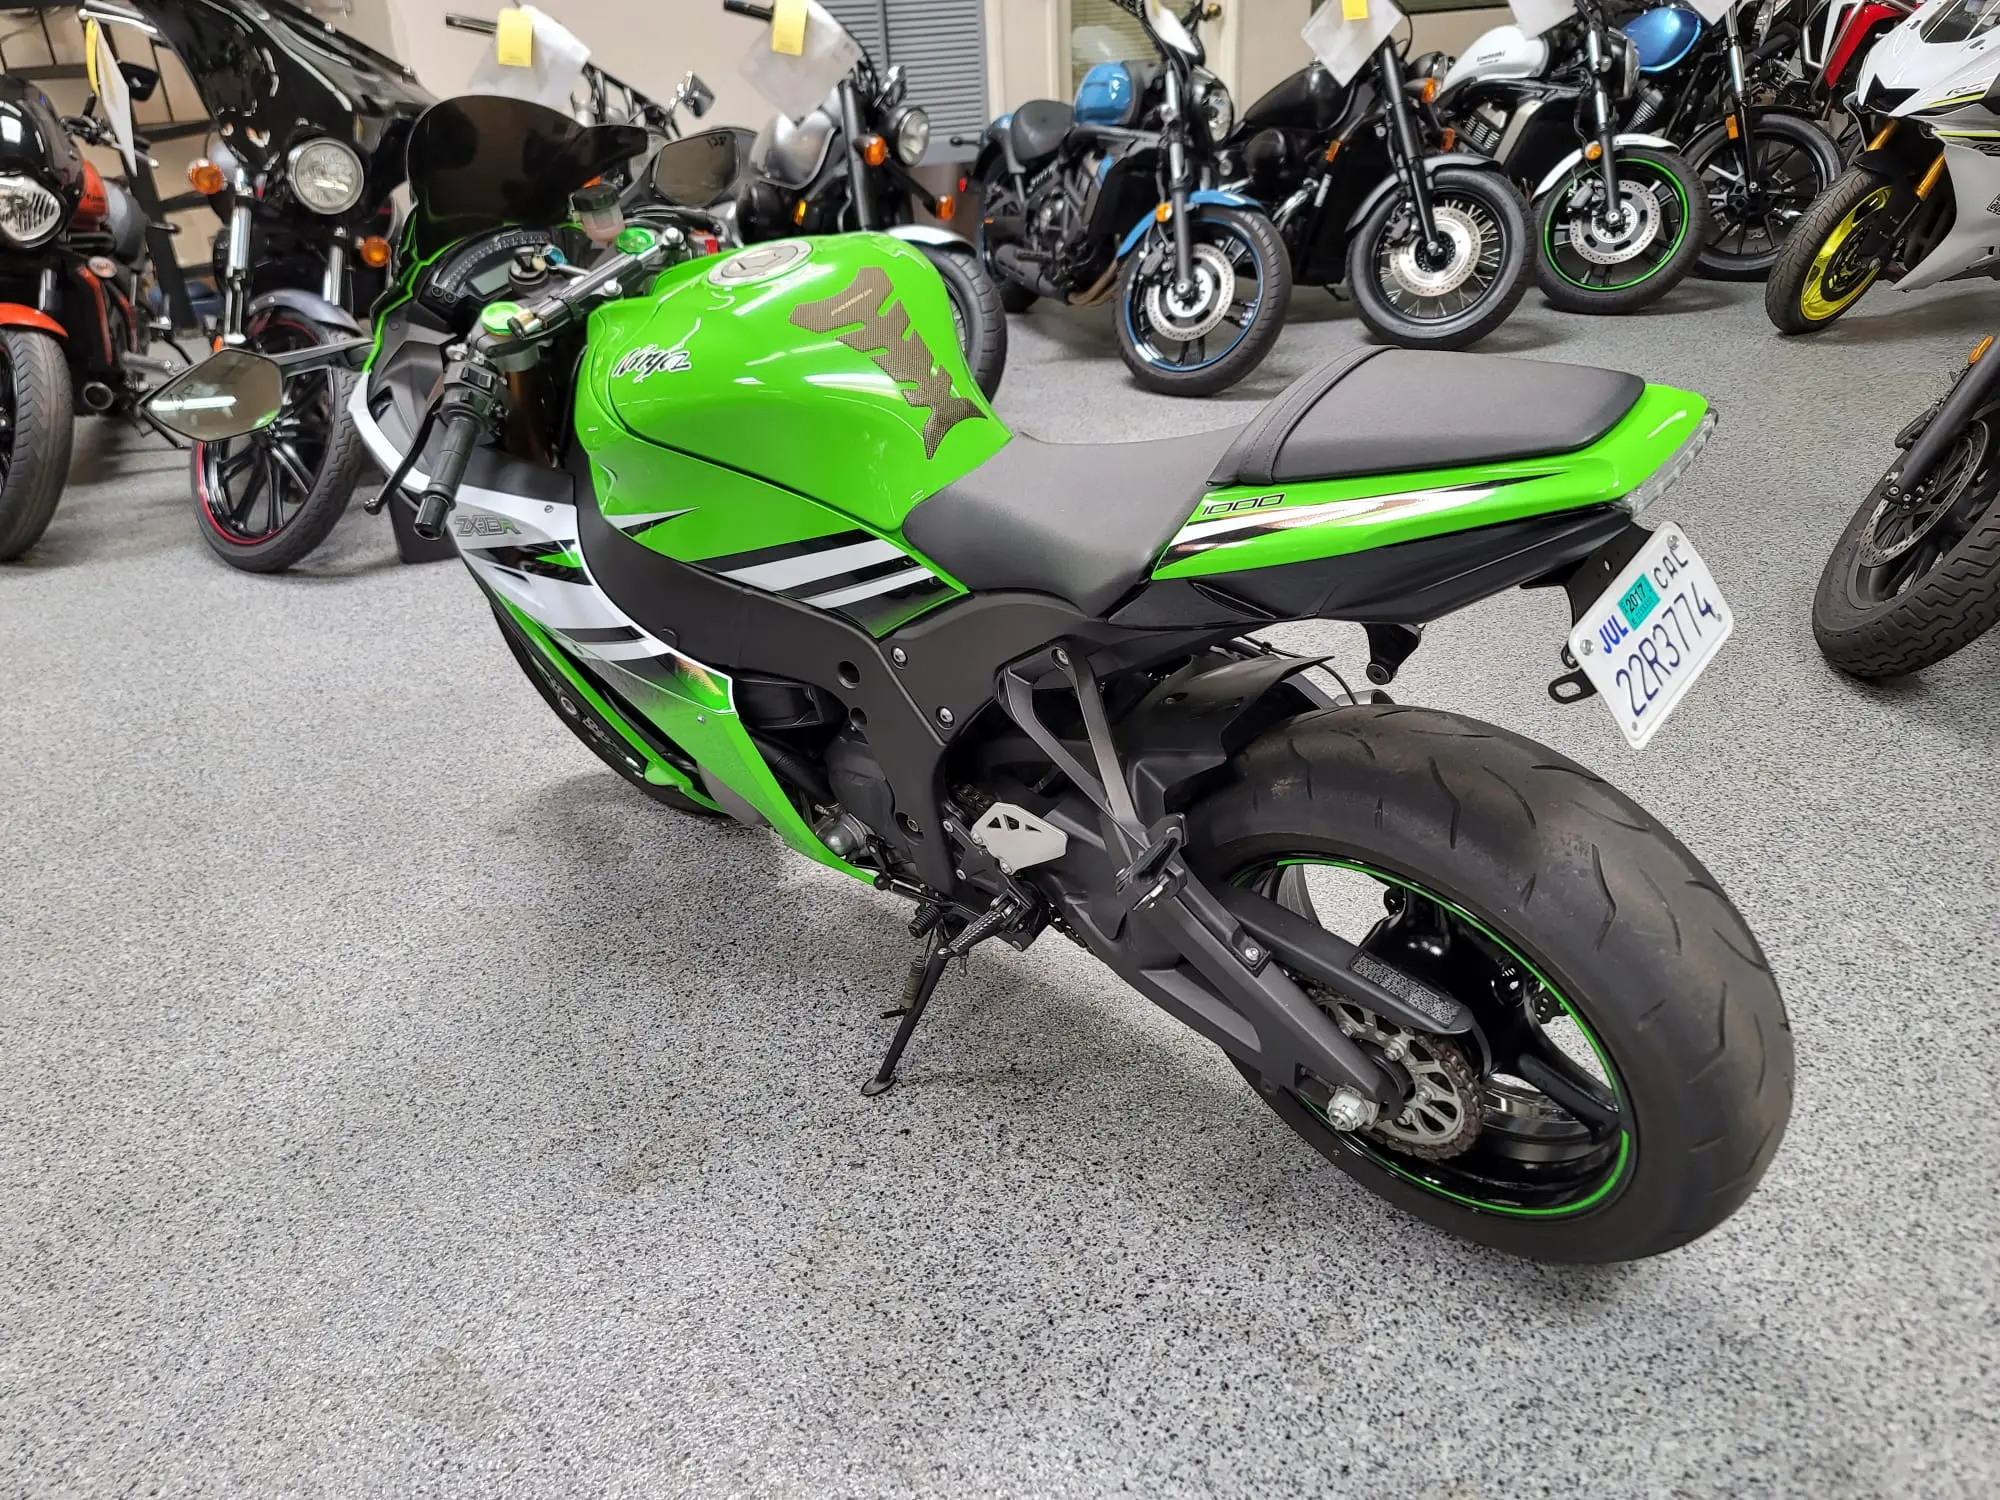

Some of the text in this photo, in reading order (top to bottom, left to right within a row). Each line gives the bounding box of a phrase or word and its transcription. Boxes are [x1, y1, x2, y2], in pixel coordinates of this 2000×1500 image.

[612, 345, 691, 384] Ninja
[1201, 493, 1286, 516] 1000
[1653, 548, 1689, 590] CAL
[1625, 583, 1648, 613] 2017
[1598, 614, 1629, 654] JUL
[1615, 581, 1717, 717] 22R3774
